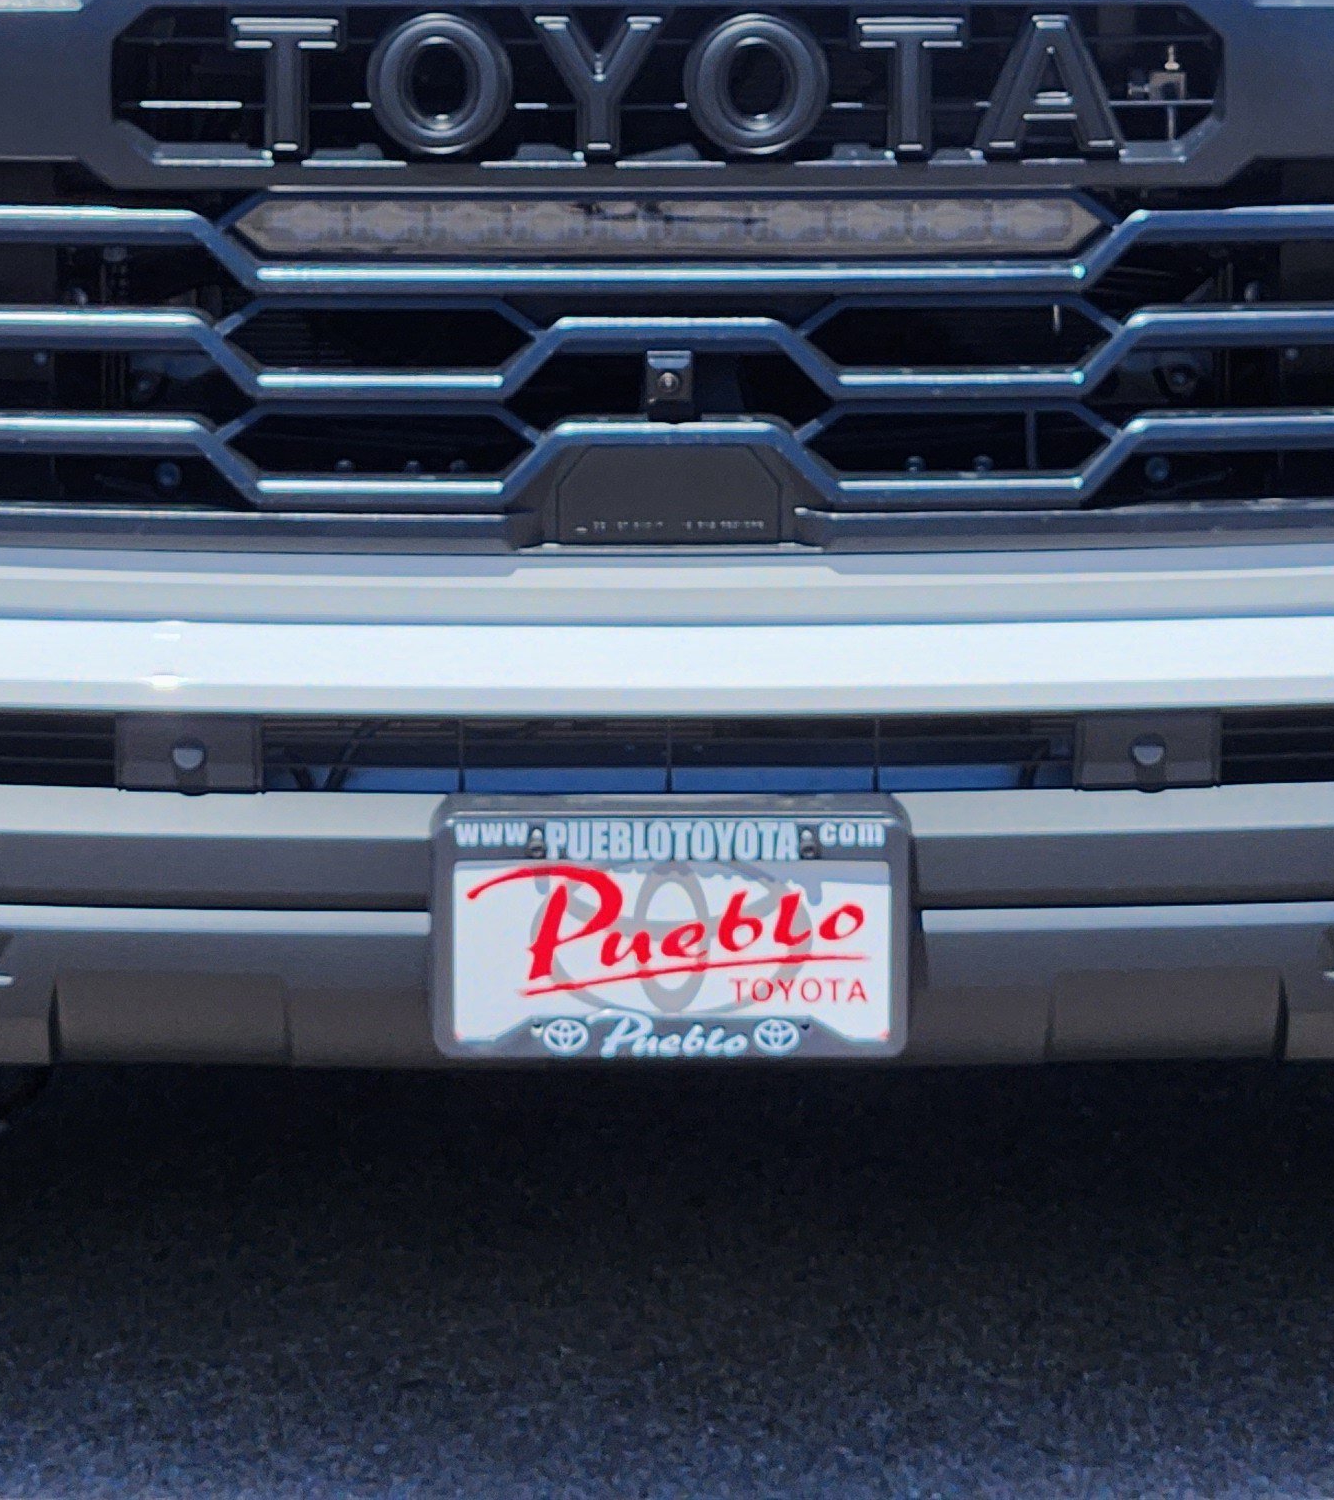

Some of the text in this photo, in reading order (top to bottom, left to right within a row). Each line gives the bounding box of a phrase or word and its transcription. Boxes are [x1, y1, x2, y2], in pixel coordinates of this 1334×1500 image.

[231, 11, 1123, 158] TOYOTA
[467, 865, 865, 981] Pueblo
[729, 977, 869, 1005] TOYOTA
[585, 1008, 748, 1058] Pueblo
